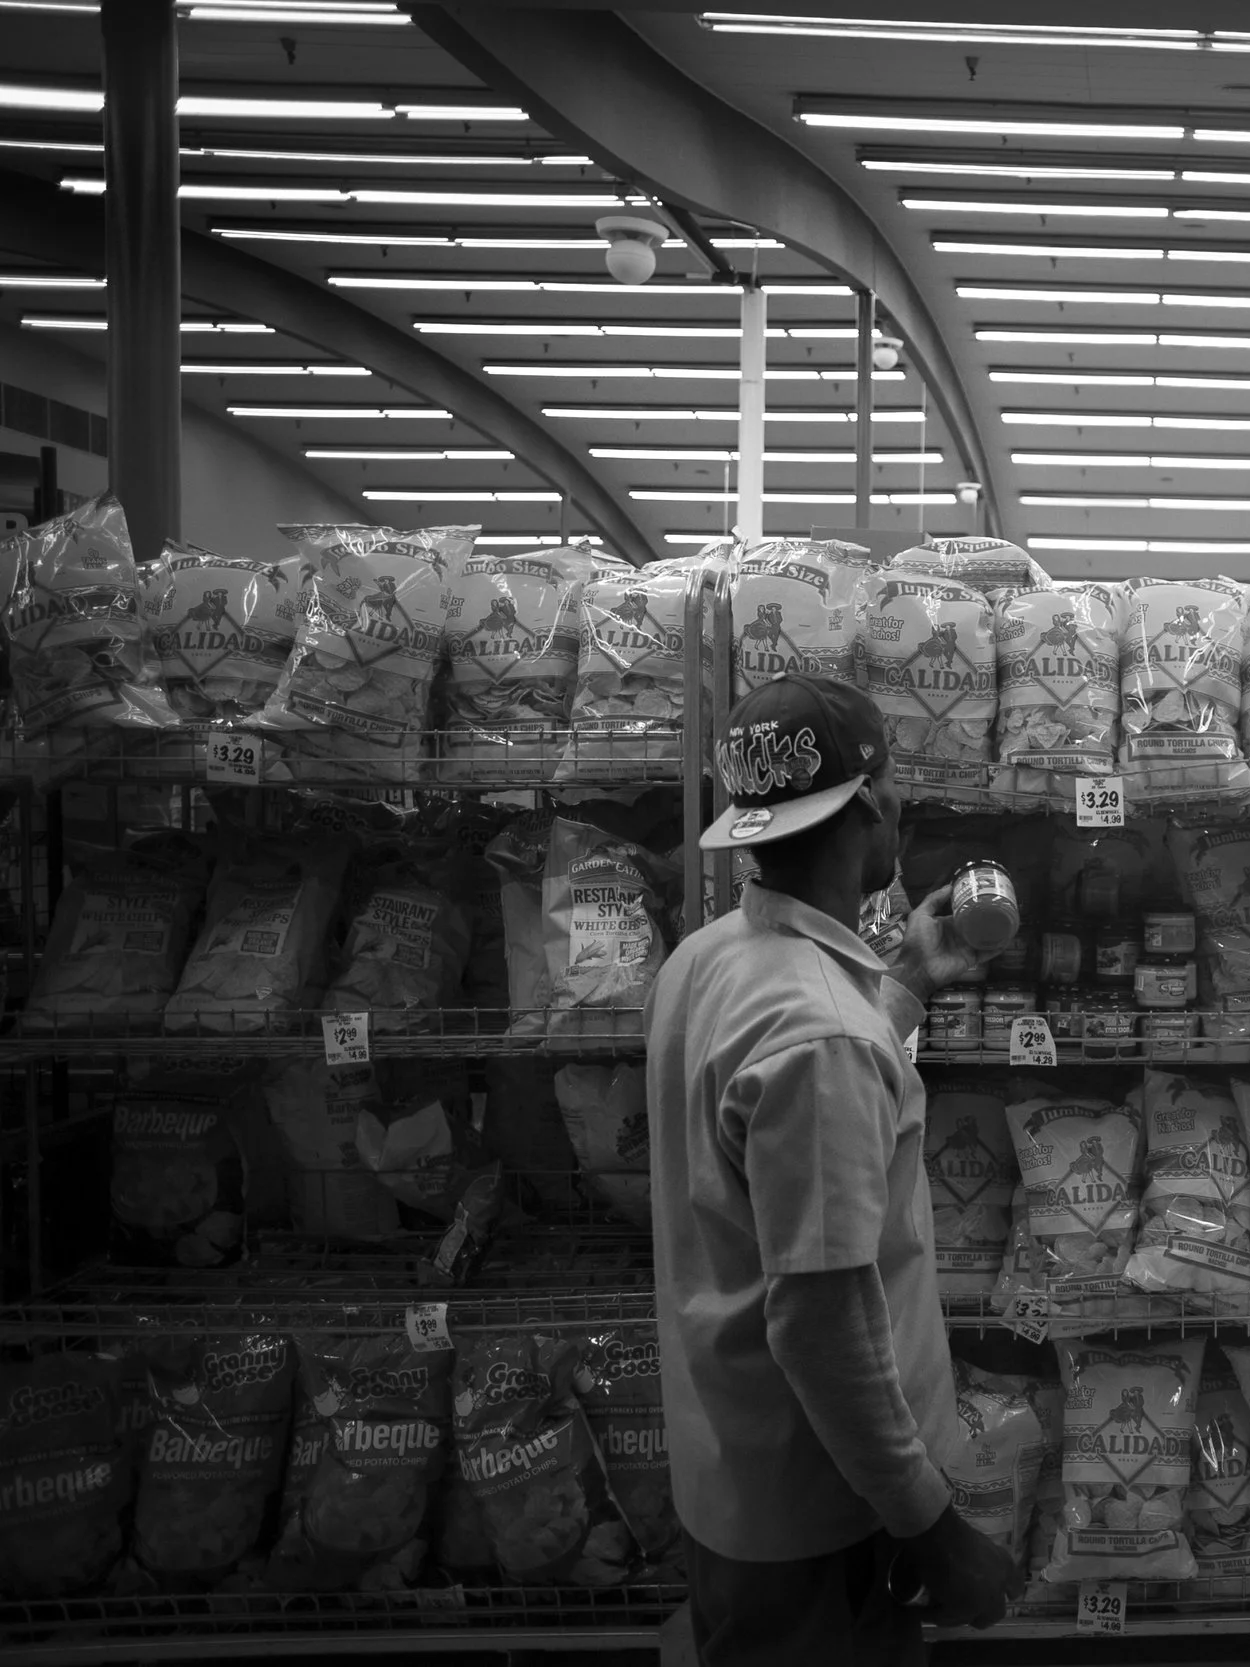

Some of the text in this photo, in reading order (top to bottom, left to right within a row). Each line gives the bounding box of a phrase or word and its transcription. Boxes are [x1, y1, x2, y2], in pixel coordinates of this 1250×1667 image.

[512, 560, 548, 576] Size
[788, 562, 826, 588] Size
[885, 666, 993, 691] CALIDAD
[1010, 657, 1111, 679] CALIDAD
[749, 720, 779, 735] YORK
[1137, 738, 1230, 748] ROUND TORTILLA CHIPS
[213, 744, 255, 766] $3.29
[1080, 790, 1120, 809] $3.29
[571, 857, 611, 874] GARDEN
[573, 920, 616, 932] WHITE
[1040, 1105, 1096, 1122] Jumbo
[1174, 1107, 1197, 1120] for
[1157, 1119, 1195, 1134] Nachos!
[1046, 1182, 1130, 1207] CALIDA
[1178, 1242, 1235, 1265] ROUND TORTILLA
[203, 1346, 286, 1375] Granny
[604, 1358, 661, 1382] Goos
[207, 1363, 275, 1392] Goose
[151, 1428, 274, 1469] Barbeque
[1077, 1433, 1181, 1457] CALIDAD
[363, 1456, 428, 1467] POTATO CHIPS
[496, 1456, 559, 1491] POTATO CHIPS
[1078, 1533, 1146, 1545] ROUND TORTILLA
[1083, 1595, 1122, 1615] $3.29
